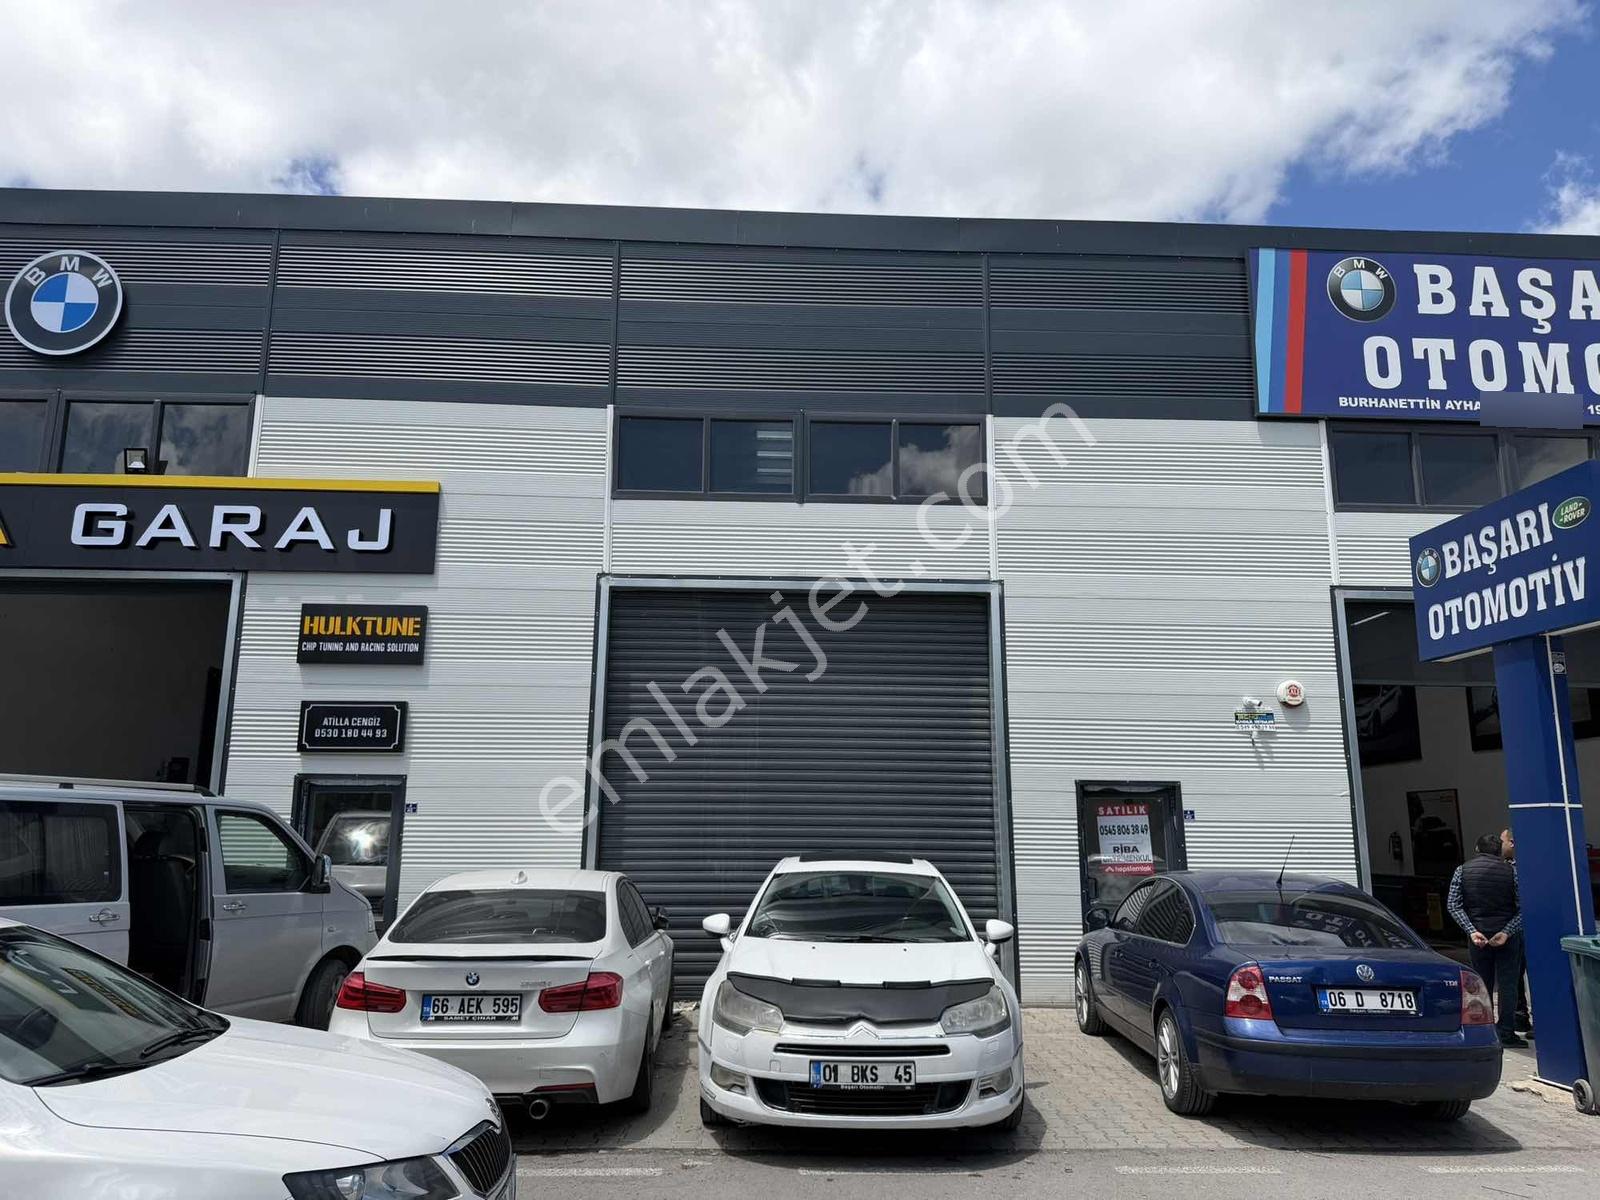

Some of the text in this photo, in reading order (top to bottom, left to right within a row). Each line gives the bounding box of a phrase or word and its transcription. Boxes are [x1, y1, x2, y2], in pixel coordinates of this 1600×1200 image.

[24, 256, 113, 288] BMW
[1333, 259, 1388, 280] BMW
[1413, 263, 1600, 334] BAŞA
[1338, 396, 1441, 410] BURHANETTİN
[71, 503, 393, 551] GARAJ
[1442, 502, 1553, 579] BAŞARI
[1428, 553, 1586, 640] OTOMOTİV
[303, 616, 421, 636] HULKTUNE
[301, 642, 419, 653] CHIP TUNING AND RACING SOLUTION
[314, 728, 388, 738] 0530 180 44 93
[1098, 805, 1146, 815] SATILIK
[1268, 975, 1304, 984] PASSAT
[432, 997, 450, 1015] 66
[458, 997, 484, 1015] AEK
[492, 997, 519, 1015] 595
[1328, 991, 1346, 1007] 06
[1355, 991, 1365, 1008] D
[1380, 992, 1414, 1009] 8718
[822, 1064, 913, 1083] 01 BKS 45
